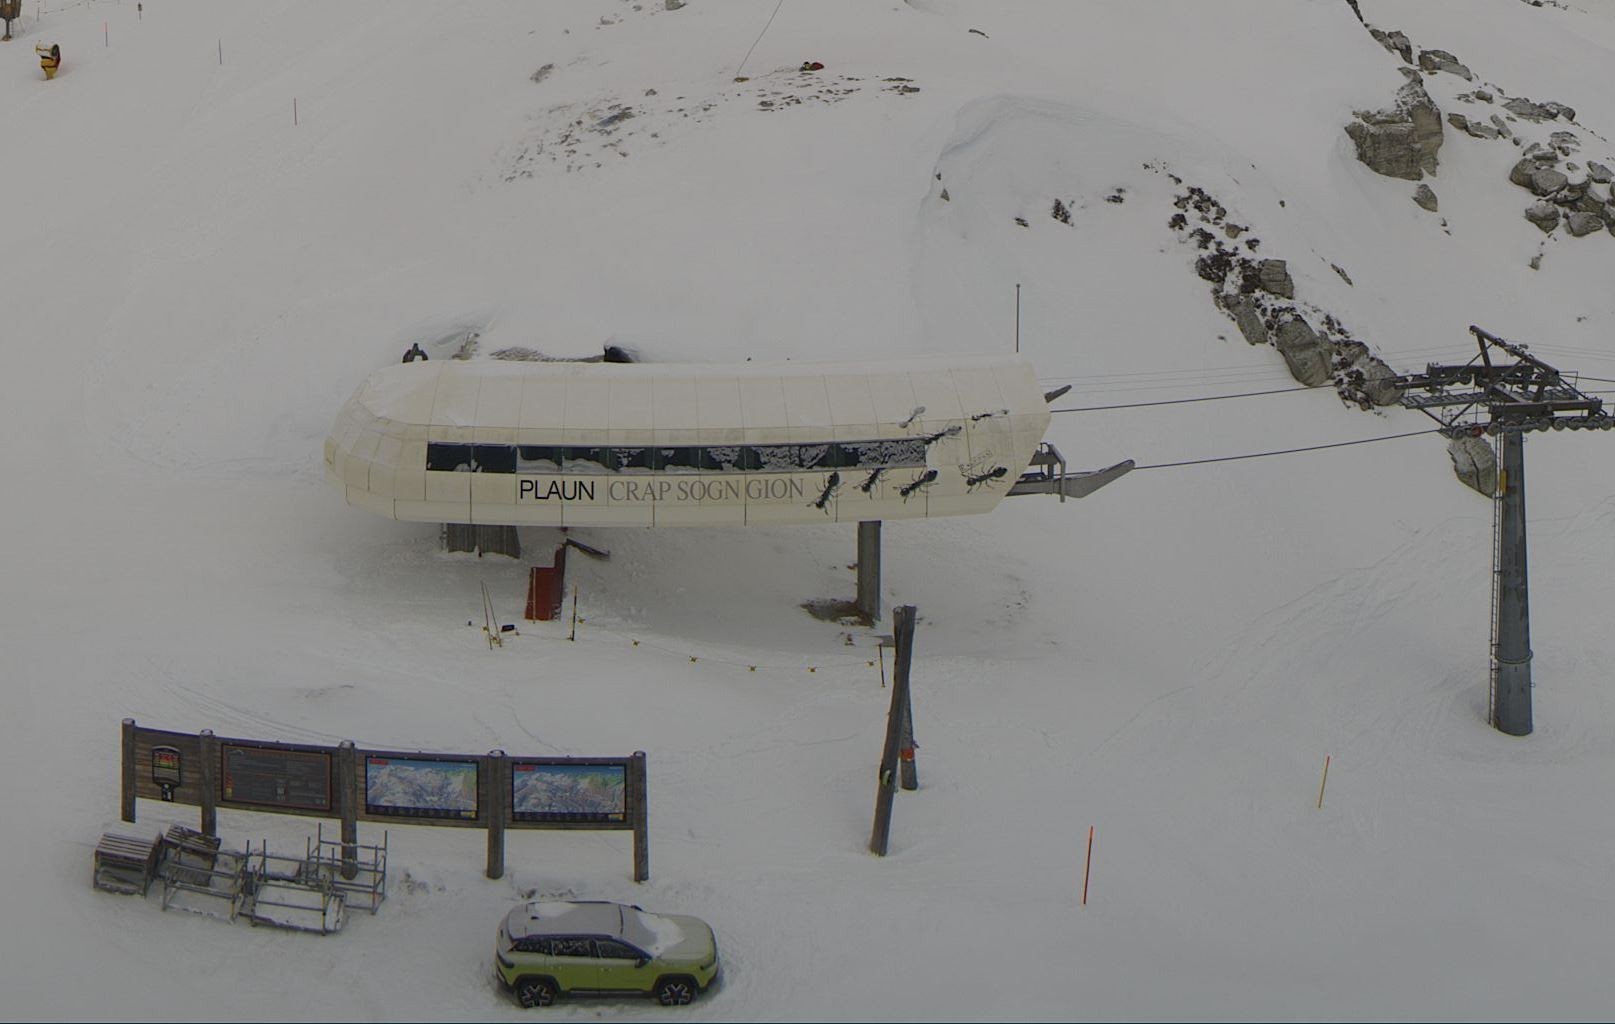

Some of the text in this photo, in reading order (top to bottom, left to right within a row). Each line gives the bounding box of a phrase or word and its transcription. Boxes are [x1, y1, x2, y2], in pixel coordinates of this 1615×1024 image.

[520, 478, 804, 501] PLAUN CRAP SOGN GION
